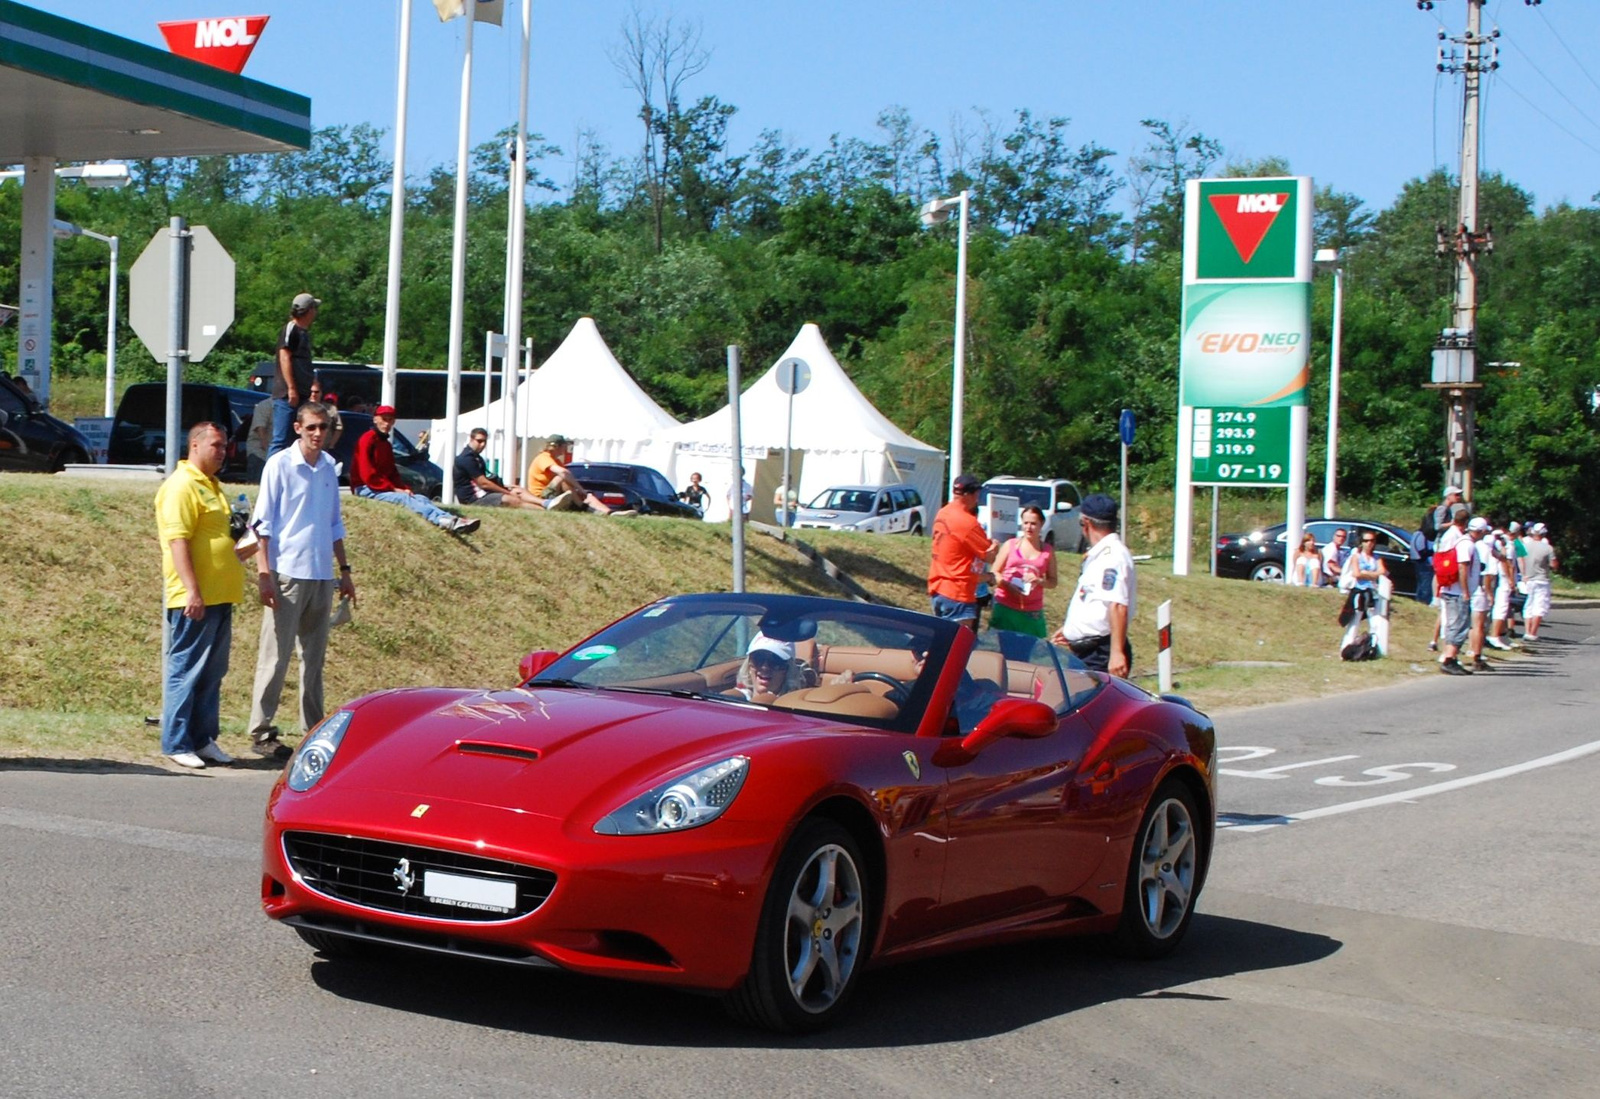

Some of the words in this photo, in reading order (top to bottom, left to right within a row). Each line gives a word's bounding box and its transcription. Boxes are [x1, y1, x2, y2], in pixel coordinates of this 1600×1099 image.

[195, 19, 257, 48] MOL
[1237, 193, 1283, 213] MOL
[1201, 333, 1259, 353] EVO
[1261, 333, 1300, 346] NEO
[1217, 412, 1257, 423] 274.9
[1216, 428, 1256, 439] 293.9
[1215, 444, 1255, 455] 319.9
[1218, 463, 1282, 479] 07-19
